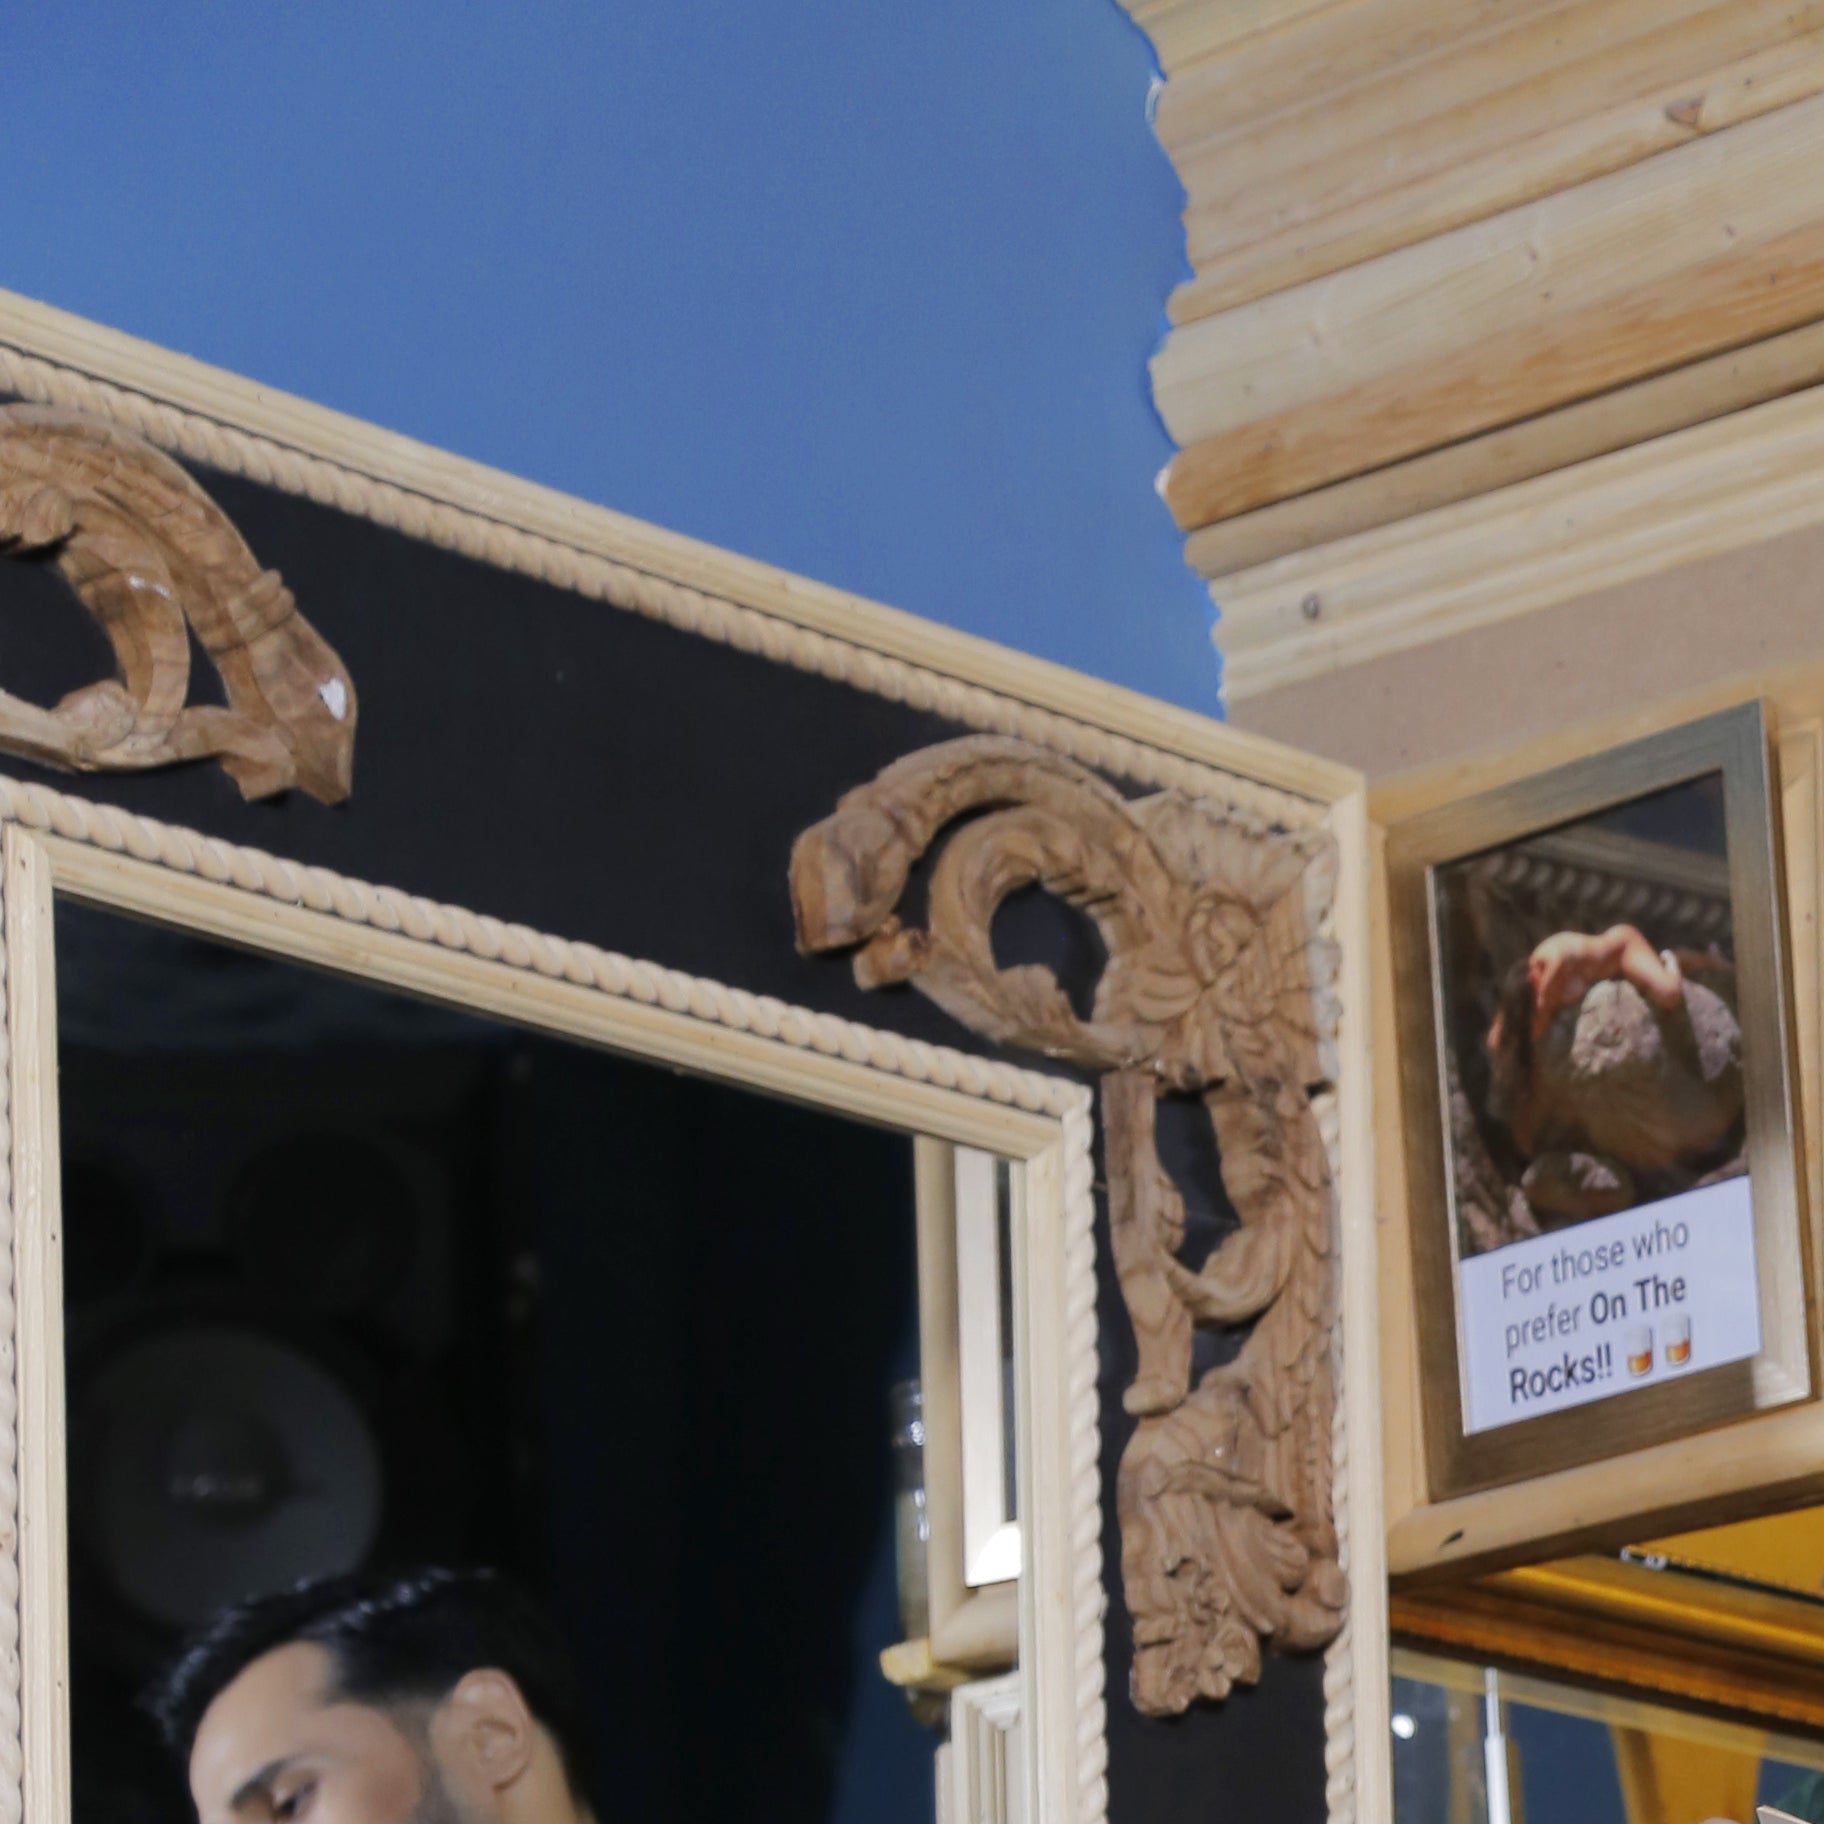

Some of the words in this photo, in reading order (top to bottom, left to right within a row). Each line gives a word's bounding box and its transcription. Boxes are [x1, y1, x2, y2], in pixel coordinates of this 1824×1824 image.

[1502, 1263, 1544, 1299] For
[1551, 1240, 1625, 1287] those
[1633, 1219, 1690, 1260] who
[1505, 1303, 1582, 1359] prefer
[1590, 1292, 1627, 1325] On
[1634, 1275, 1687, 1313] The
[1510, 1343, 1613, 1404] Rocks!!
